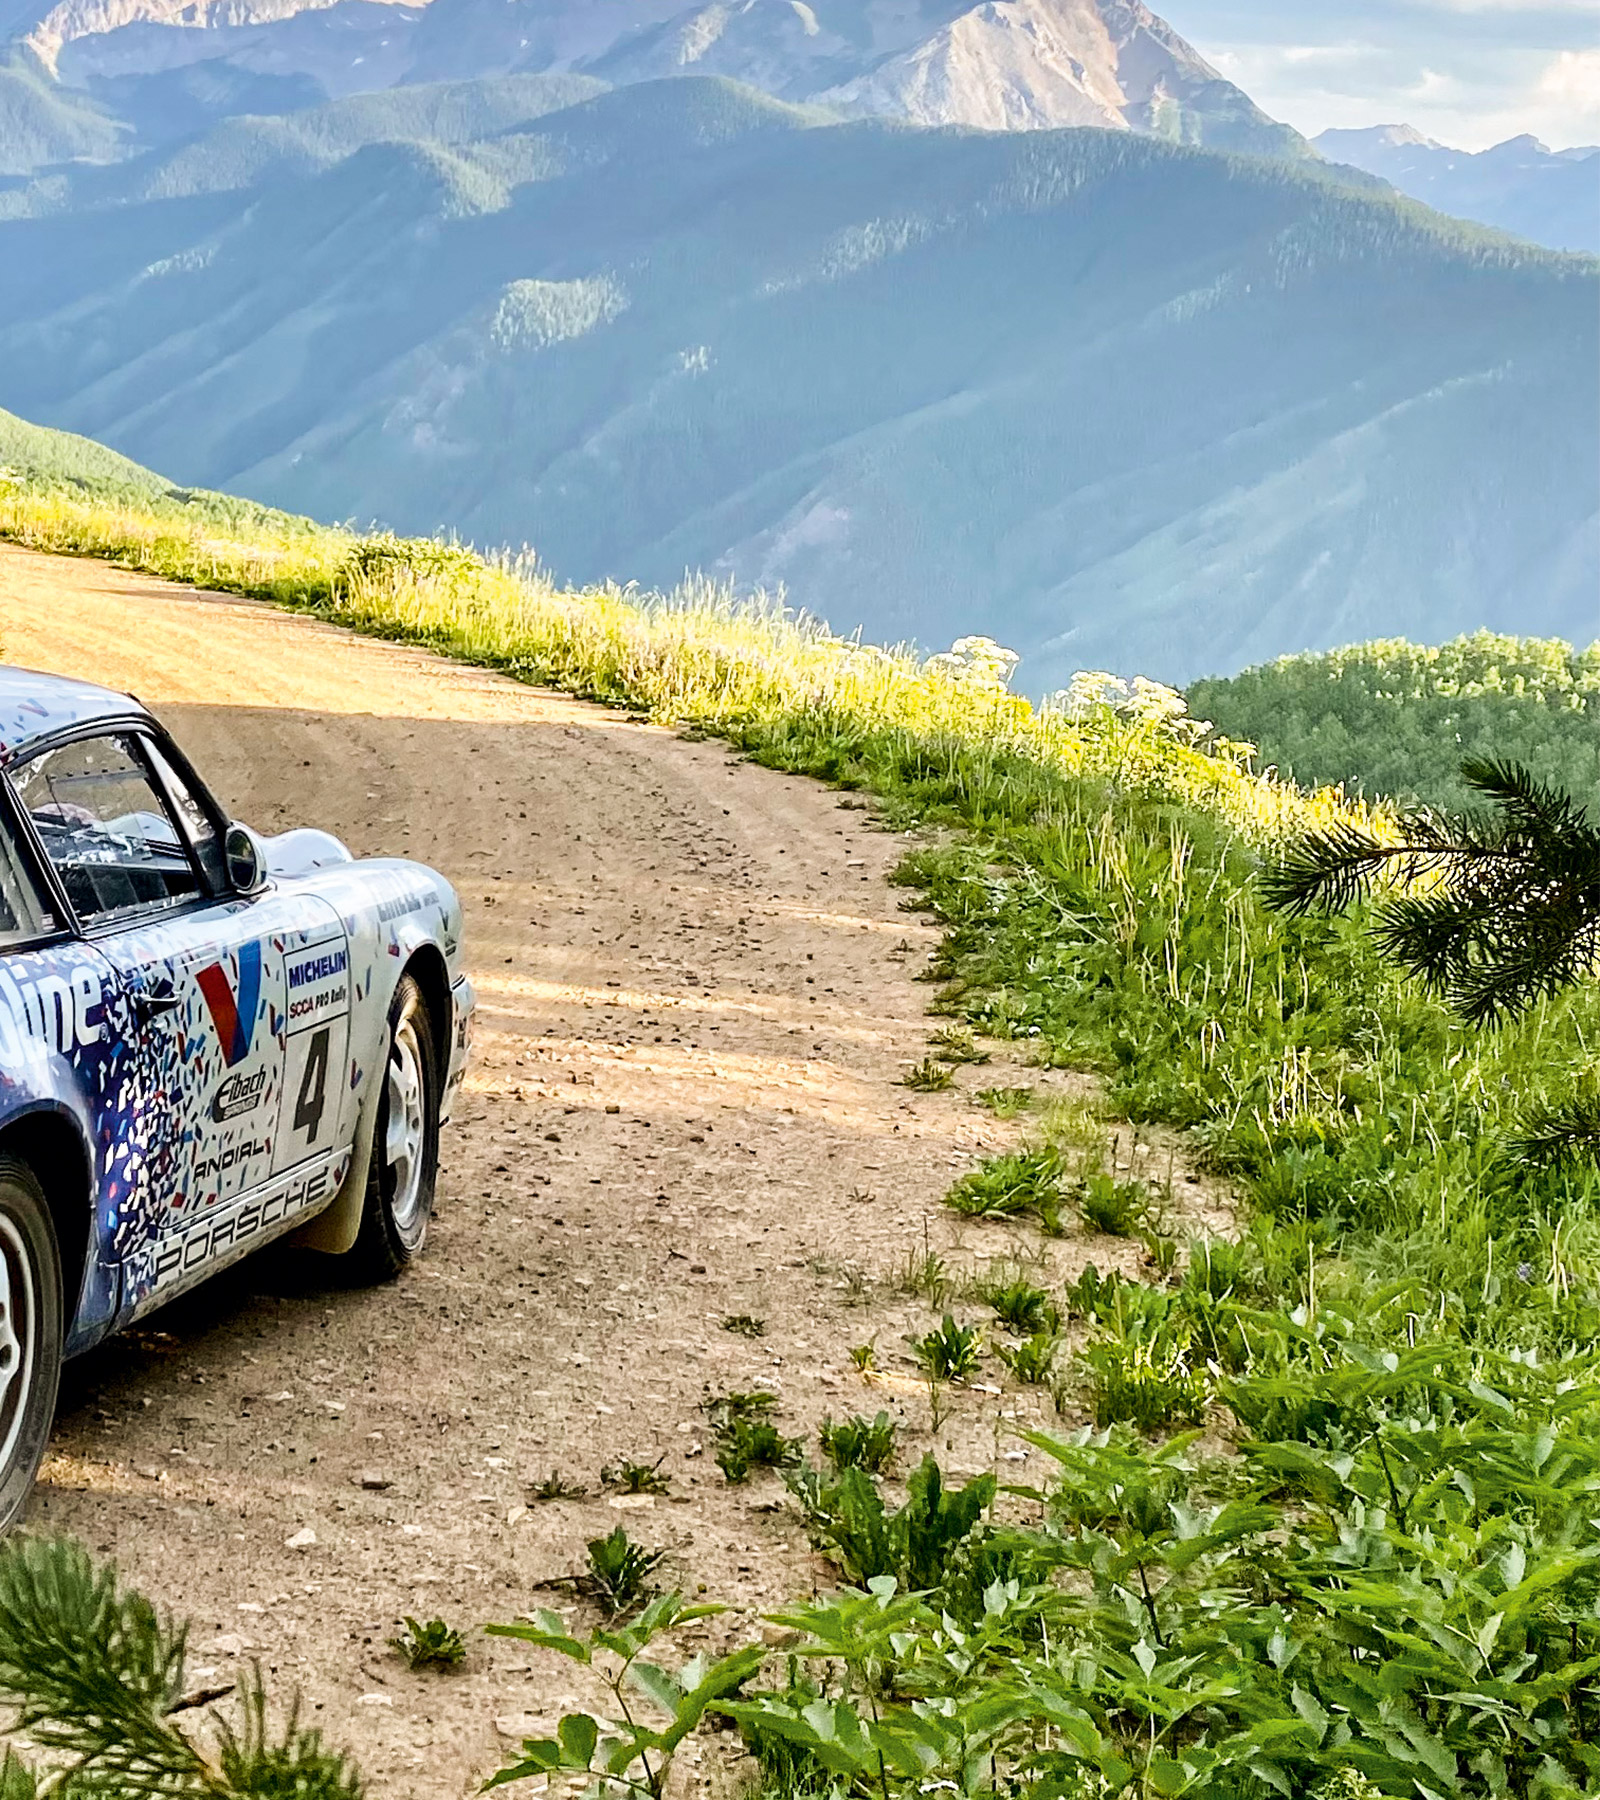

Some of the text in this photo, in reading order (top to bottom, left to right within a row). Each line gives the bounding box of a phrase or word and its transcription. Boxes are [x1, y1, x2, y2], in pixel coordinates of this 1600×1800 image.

[289, 951, 347, 988] MICHELIN
[293, 1027, 330, 1144] 4
[193, 1138, 264, 1182] ANDIAL
[153, 1165, 330, 1285] PORSCHE
